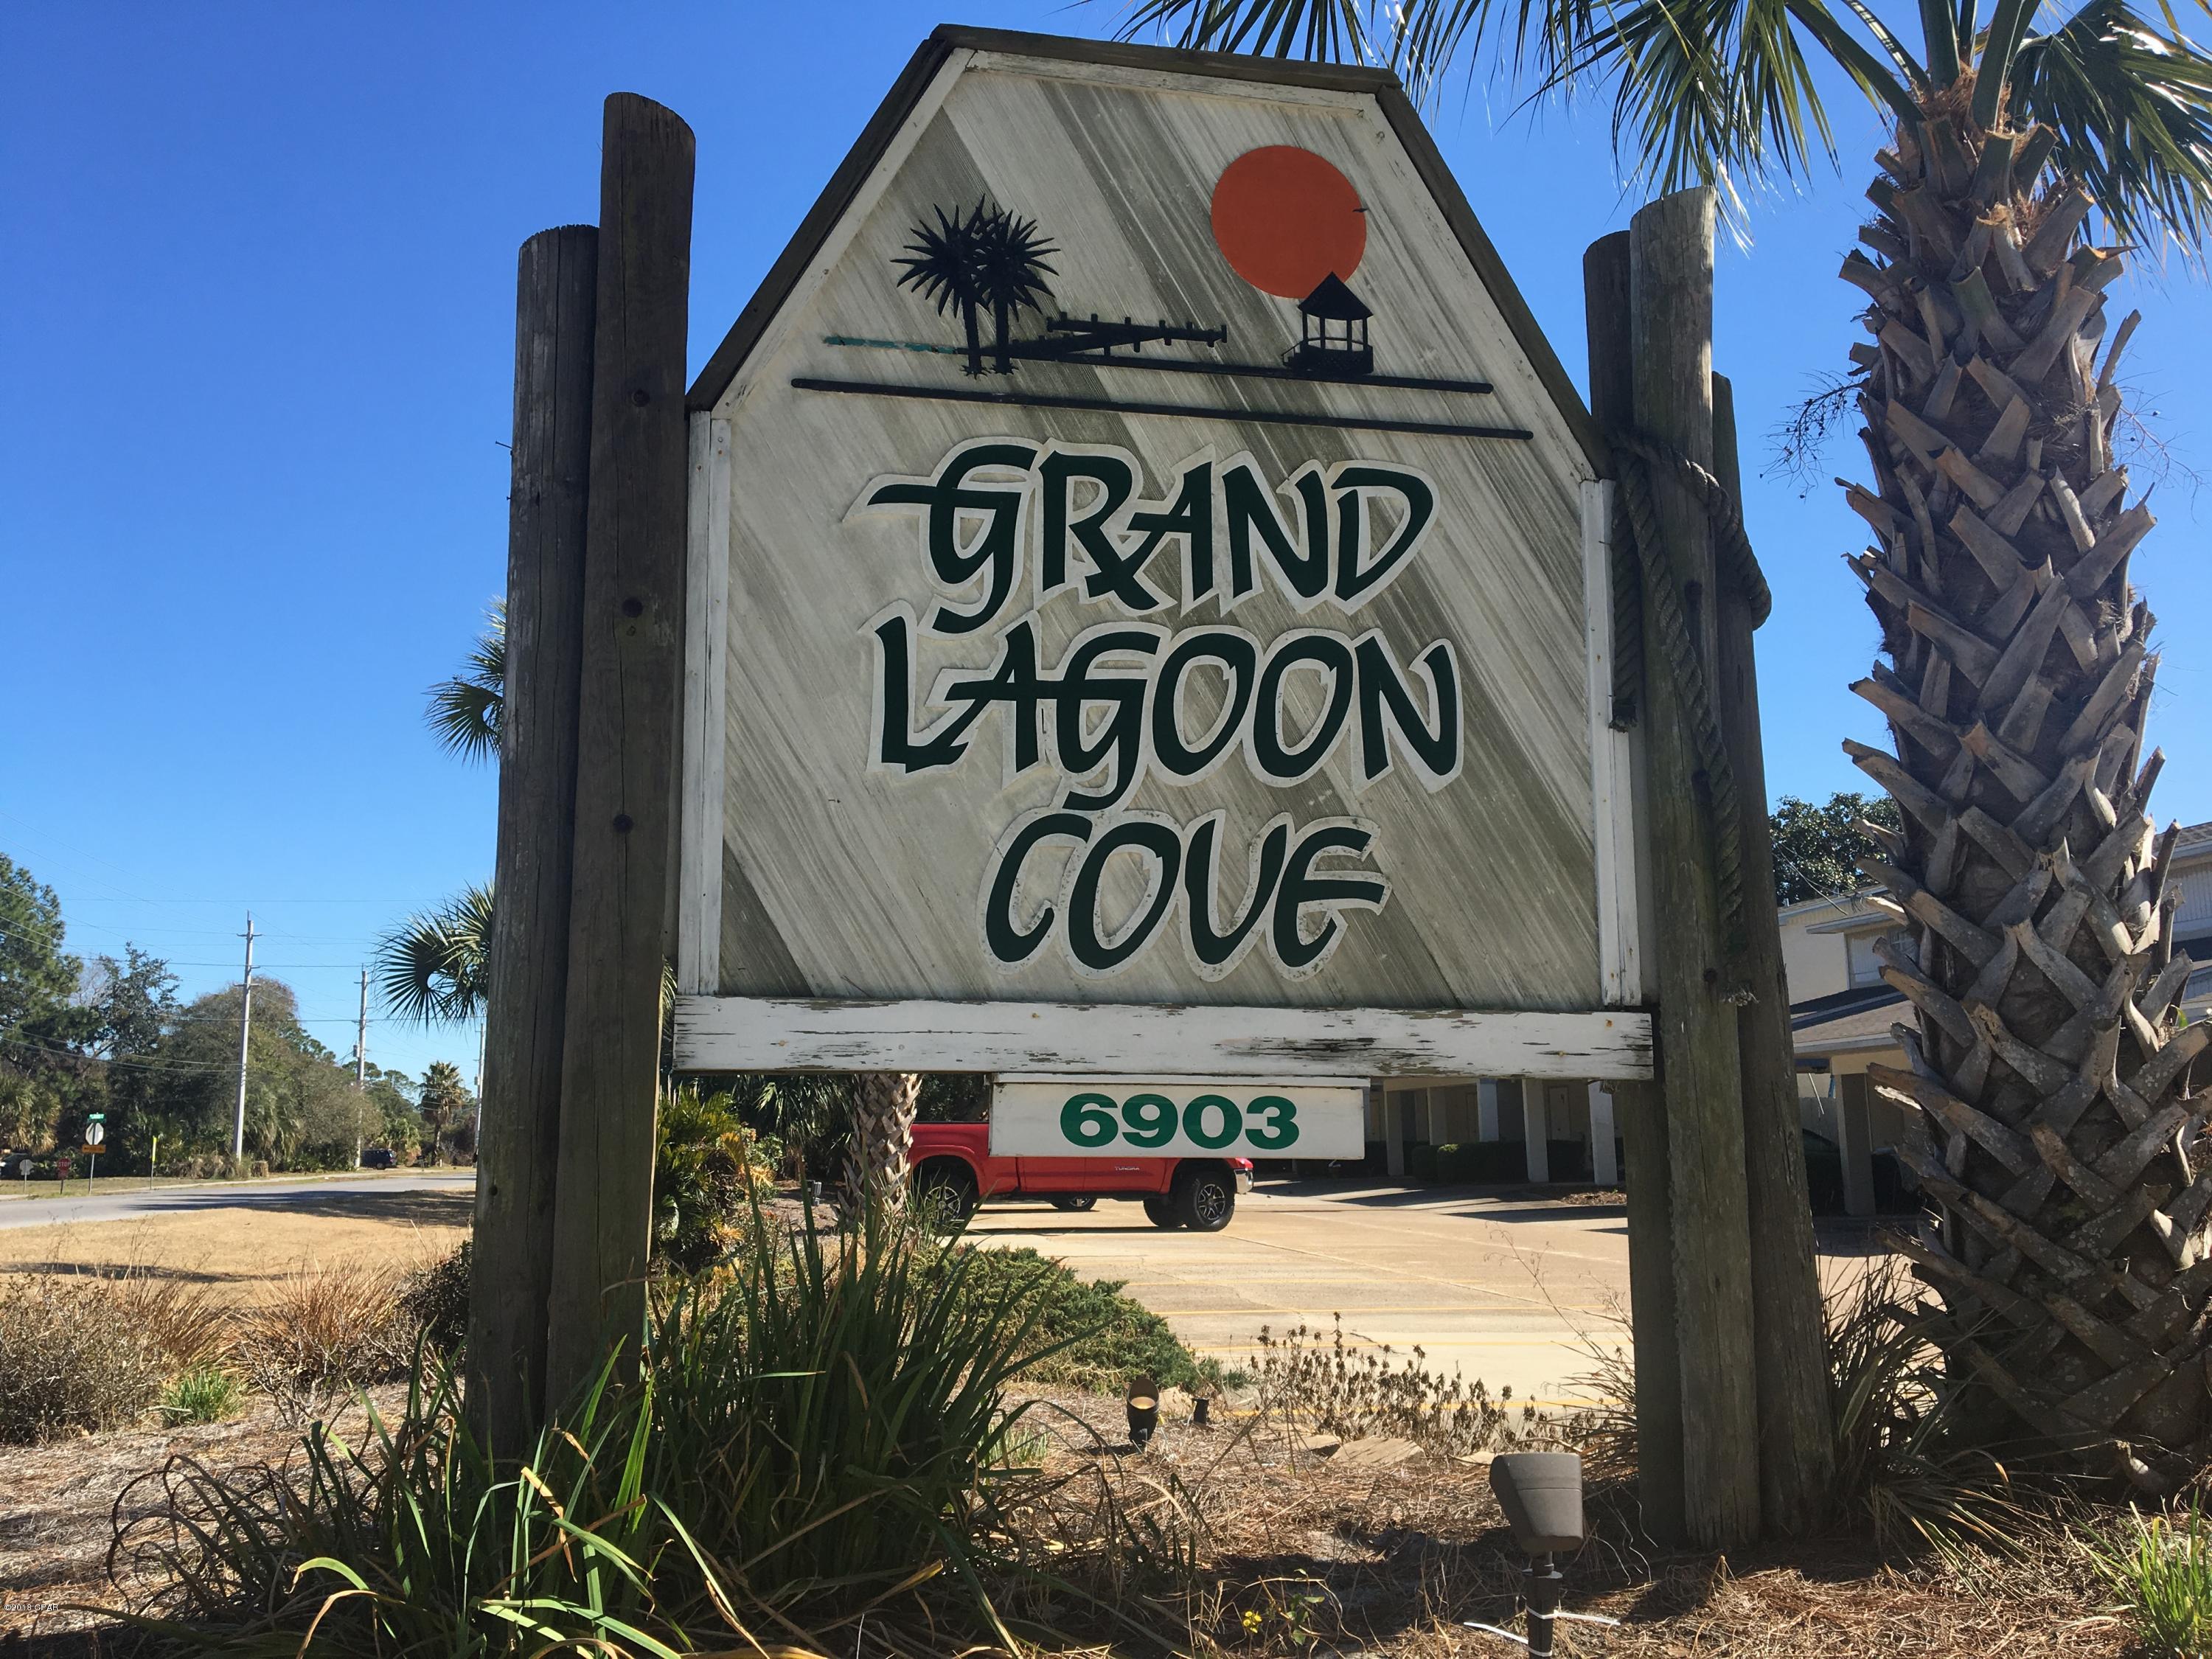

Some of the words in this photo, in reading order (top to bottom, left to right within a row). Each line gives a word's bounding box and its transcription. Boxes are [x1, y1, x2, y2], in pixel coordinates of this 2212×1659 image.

[866, 444, 1435, 634] GRAND
[874, 615, 1458, 810] LAGOON
[985, 813, 1385, 969] COVE
[1060, 1093, 1300, 1150] 6903
